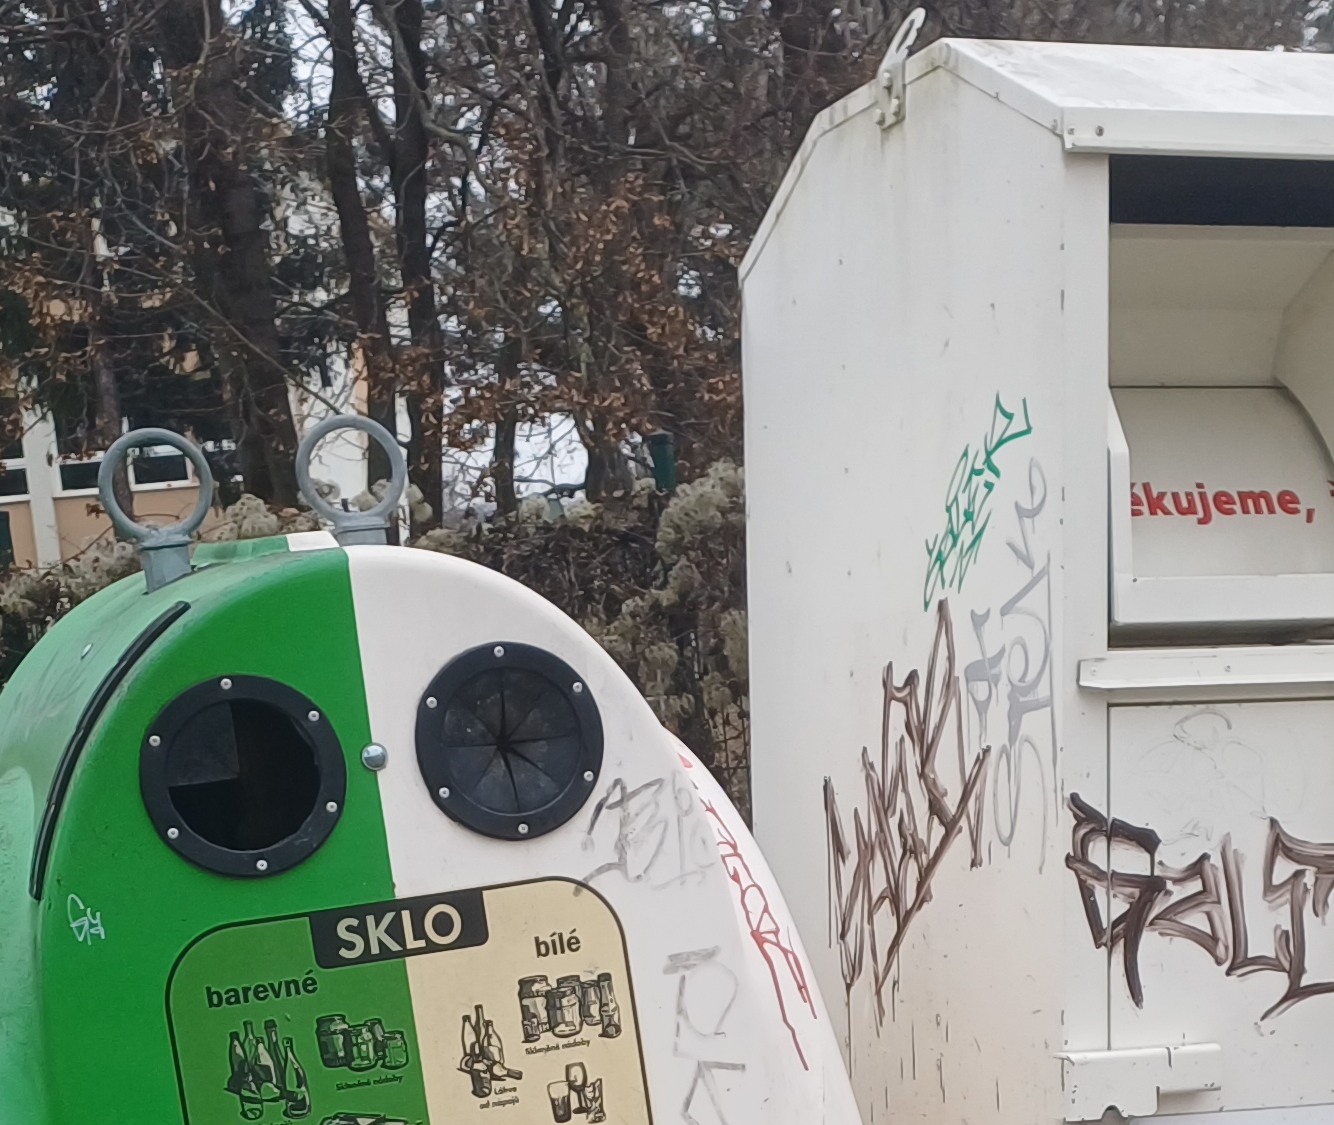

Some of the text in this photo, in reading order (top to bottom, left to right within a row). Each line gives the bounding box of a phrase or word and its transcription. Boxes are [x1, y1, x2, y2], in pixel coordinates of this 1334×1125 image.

[1131, 481, 1315, 525] ěkujeme,
[336, 902, 462, 959] SKLO
[205, 929, 581, 1009] barevné bílé
